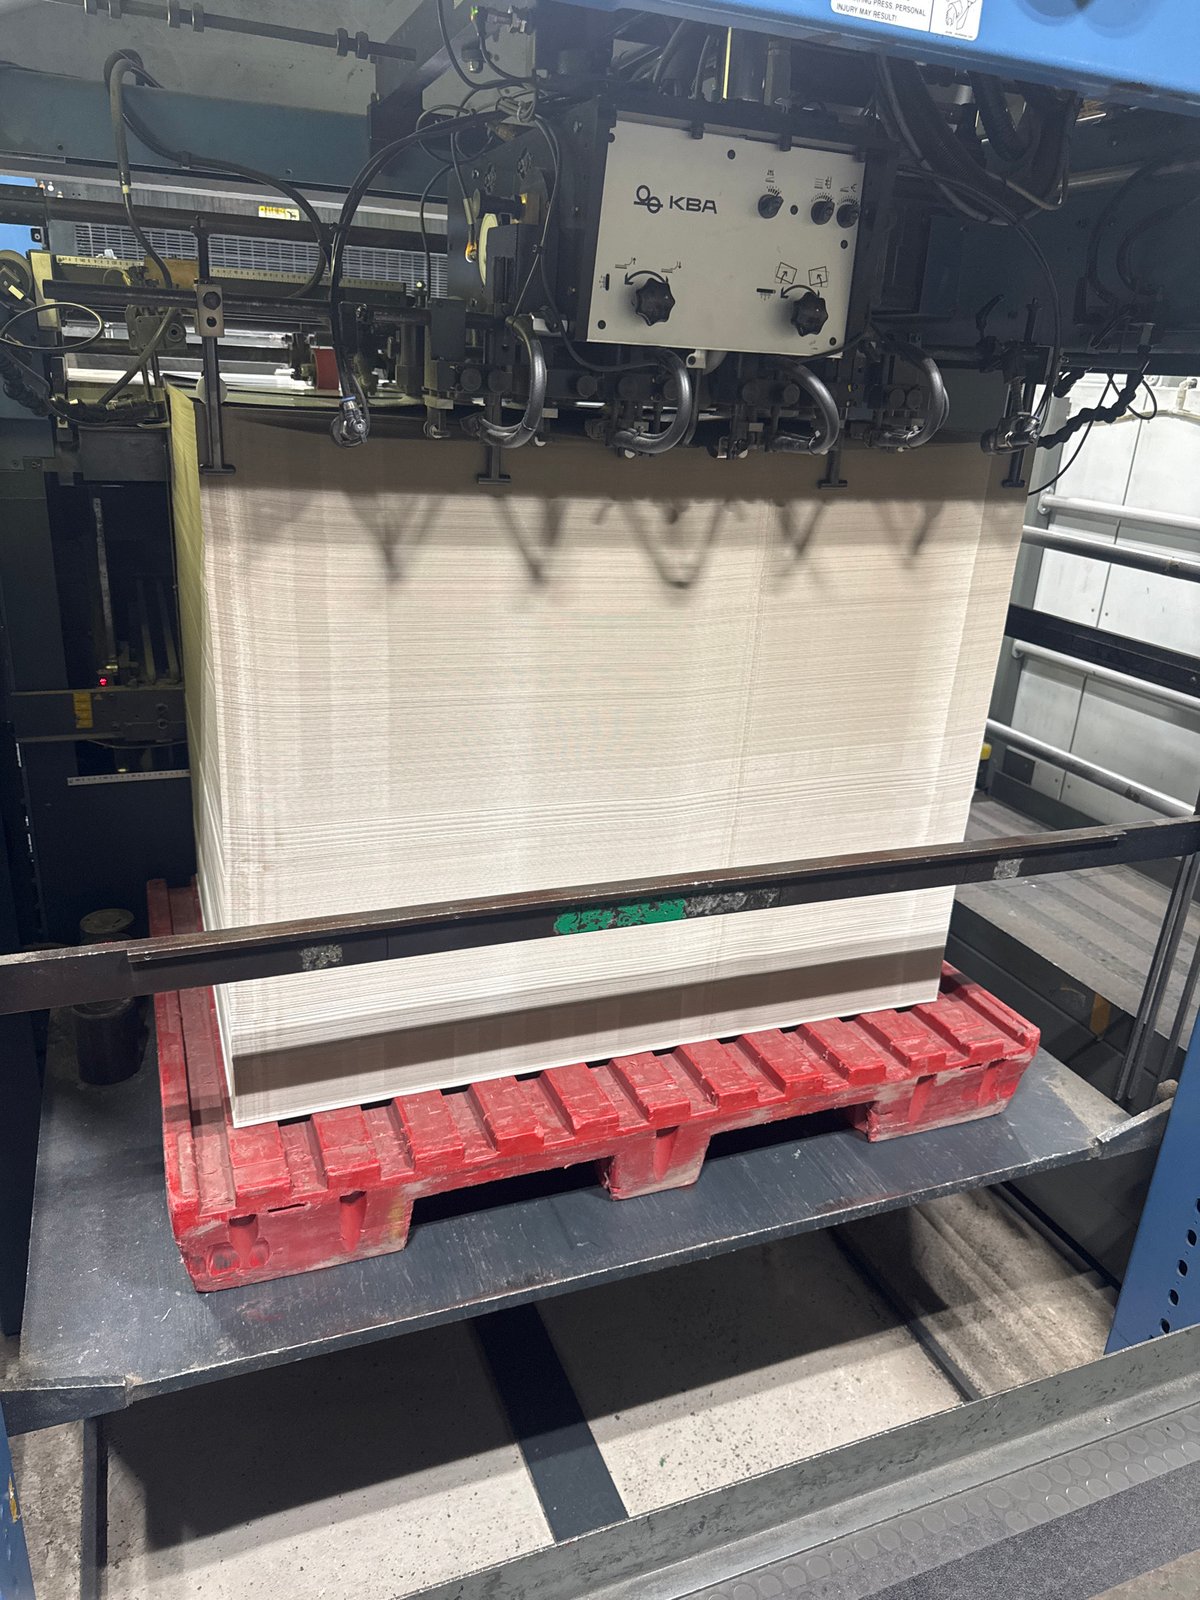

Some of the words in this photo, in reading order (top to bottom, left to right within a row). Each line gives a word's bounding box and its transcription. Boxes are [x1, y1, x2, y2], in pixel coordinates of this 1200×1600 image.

[836, 3, 858, 14] INJURY
[859, 7, 872, 17] MAY
[873, 10, 897, 22] RESULT!
[895, 3, 926, 17] PERSONAL
[669, 195, 718, 215] KBA
